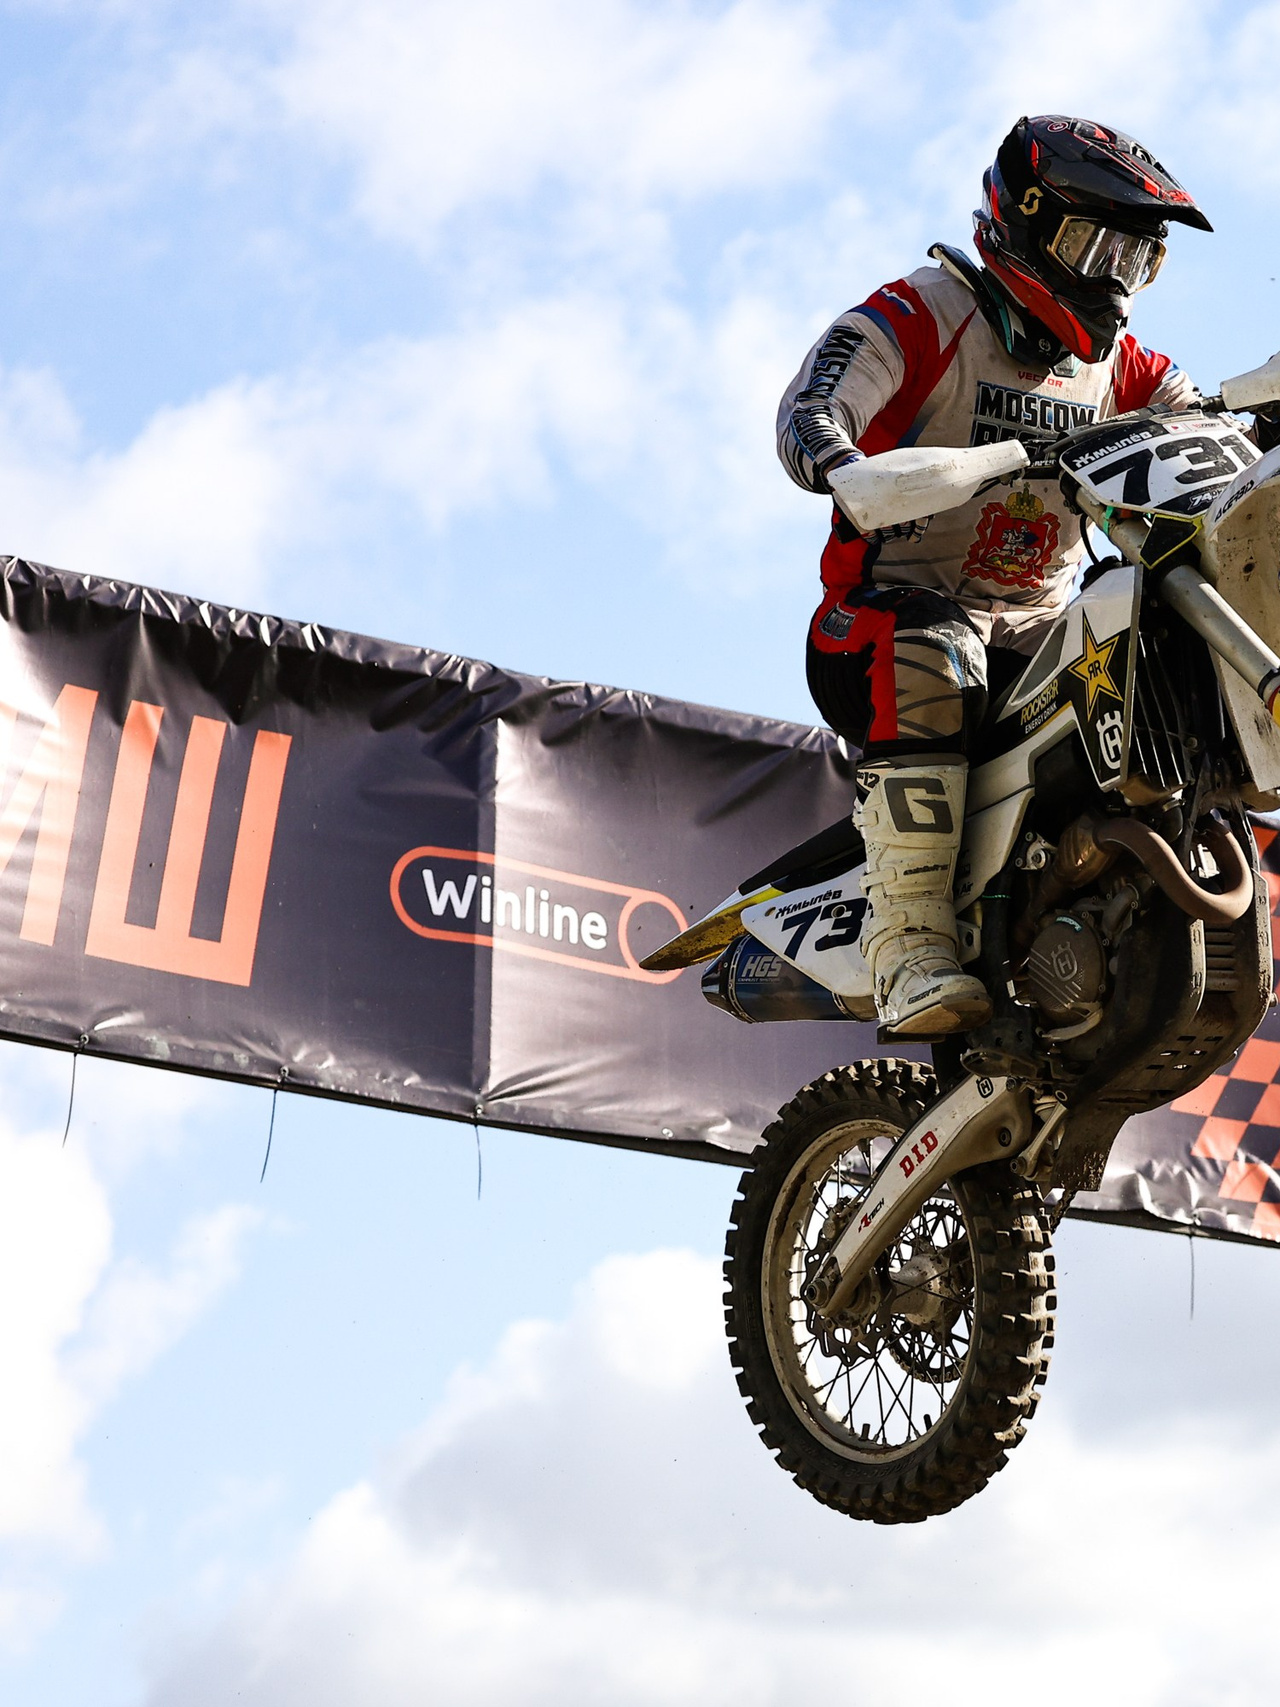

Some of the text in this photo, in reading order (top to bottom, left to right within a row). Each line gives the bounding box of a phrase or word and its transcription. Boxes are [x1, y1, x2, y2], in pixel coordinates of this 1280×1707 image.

[1018, 371, 1063, 388] VECTOR
[978, 384, 1095, 433] MOSCOW
[1087, 433, 1257, 507] 731
[1020, 678, 1059, 726] ROCKSTAR
[1025, 702, 1058, 734] ENERGY DRINK
[884, 777, 955, 834] G
[422, 868, 608, 950] Winline
[774, 889, 843, 919] Жмылёв
[781, 897, 873, 962] 73
[741, 954, 783, 978] HGS
[899, 1131, 939, 1179] D.I.D
